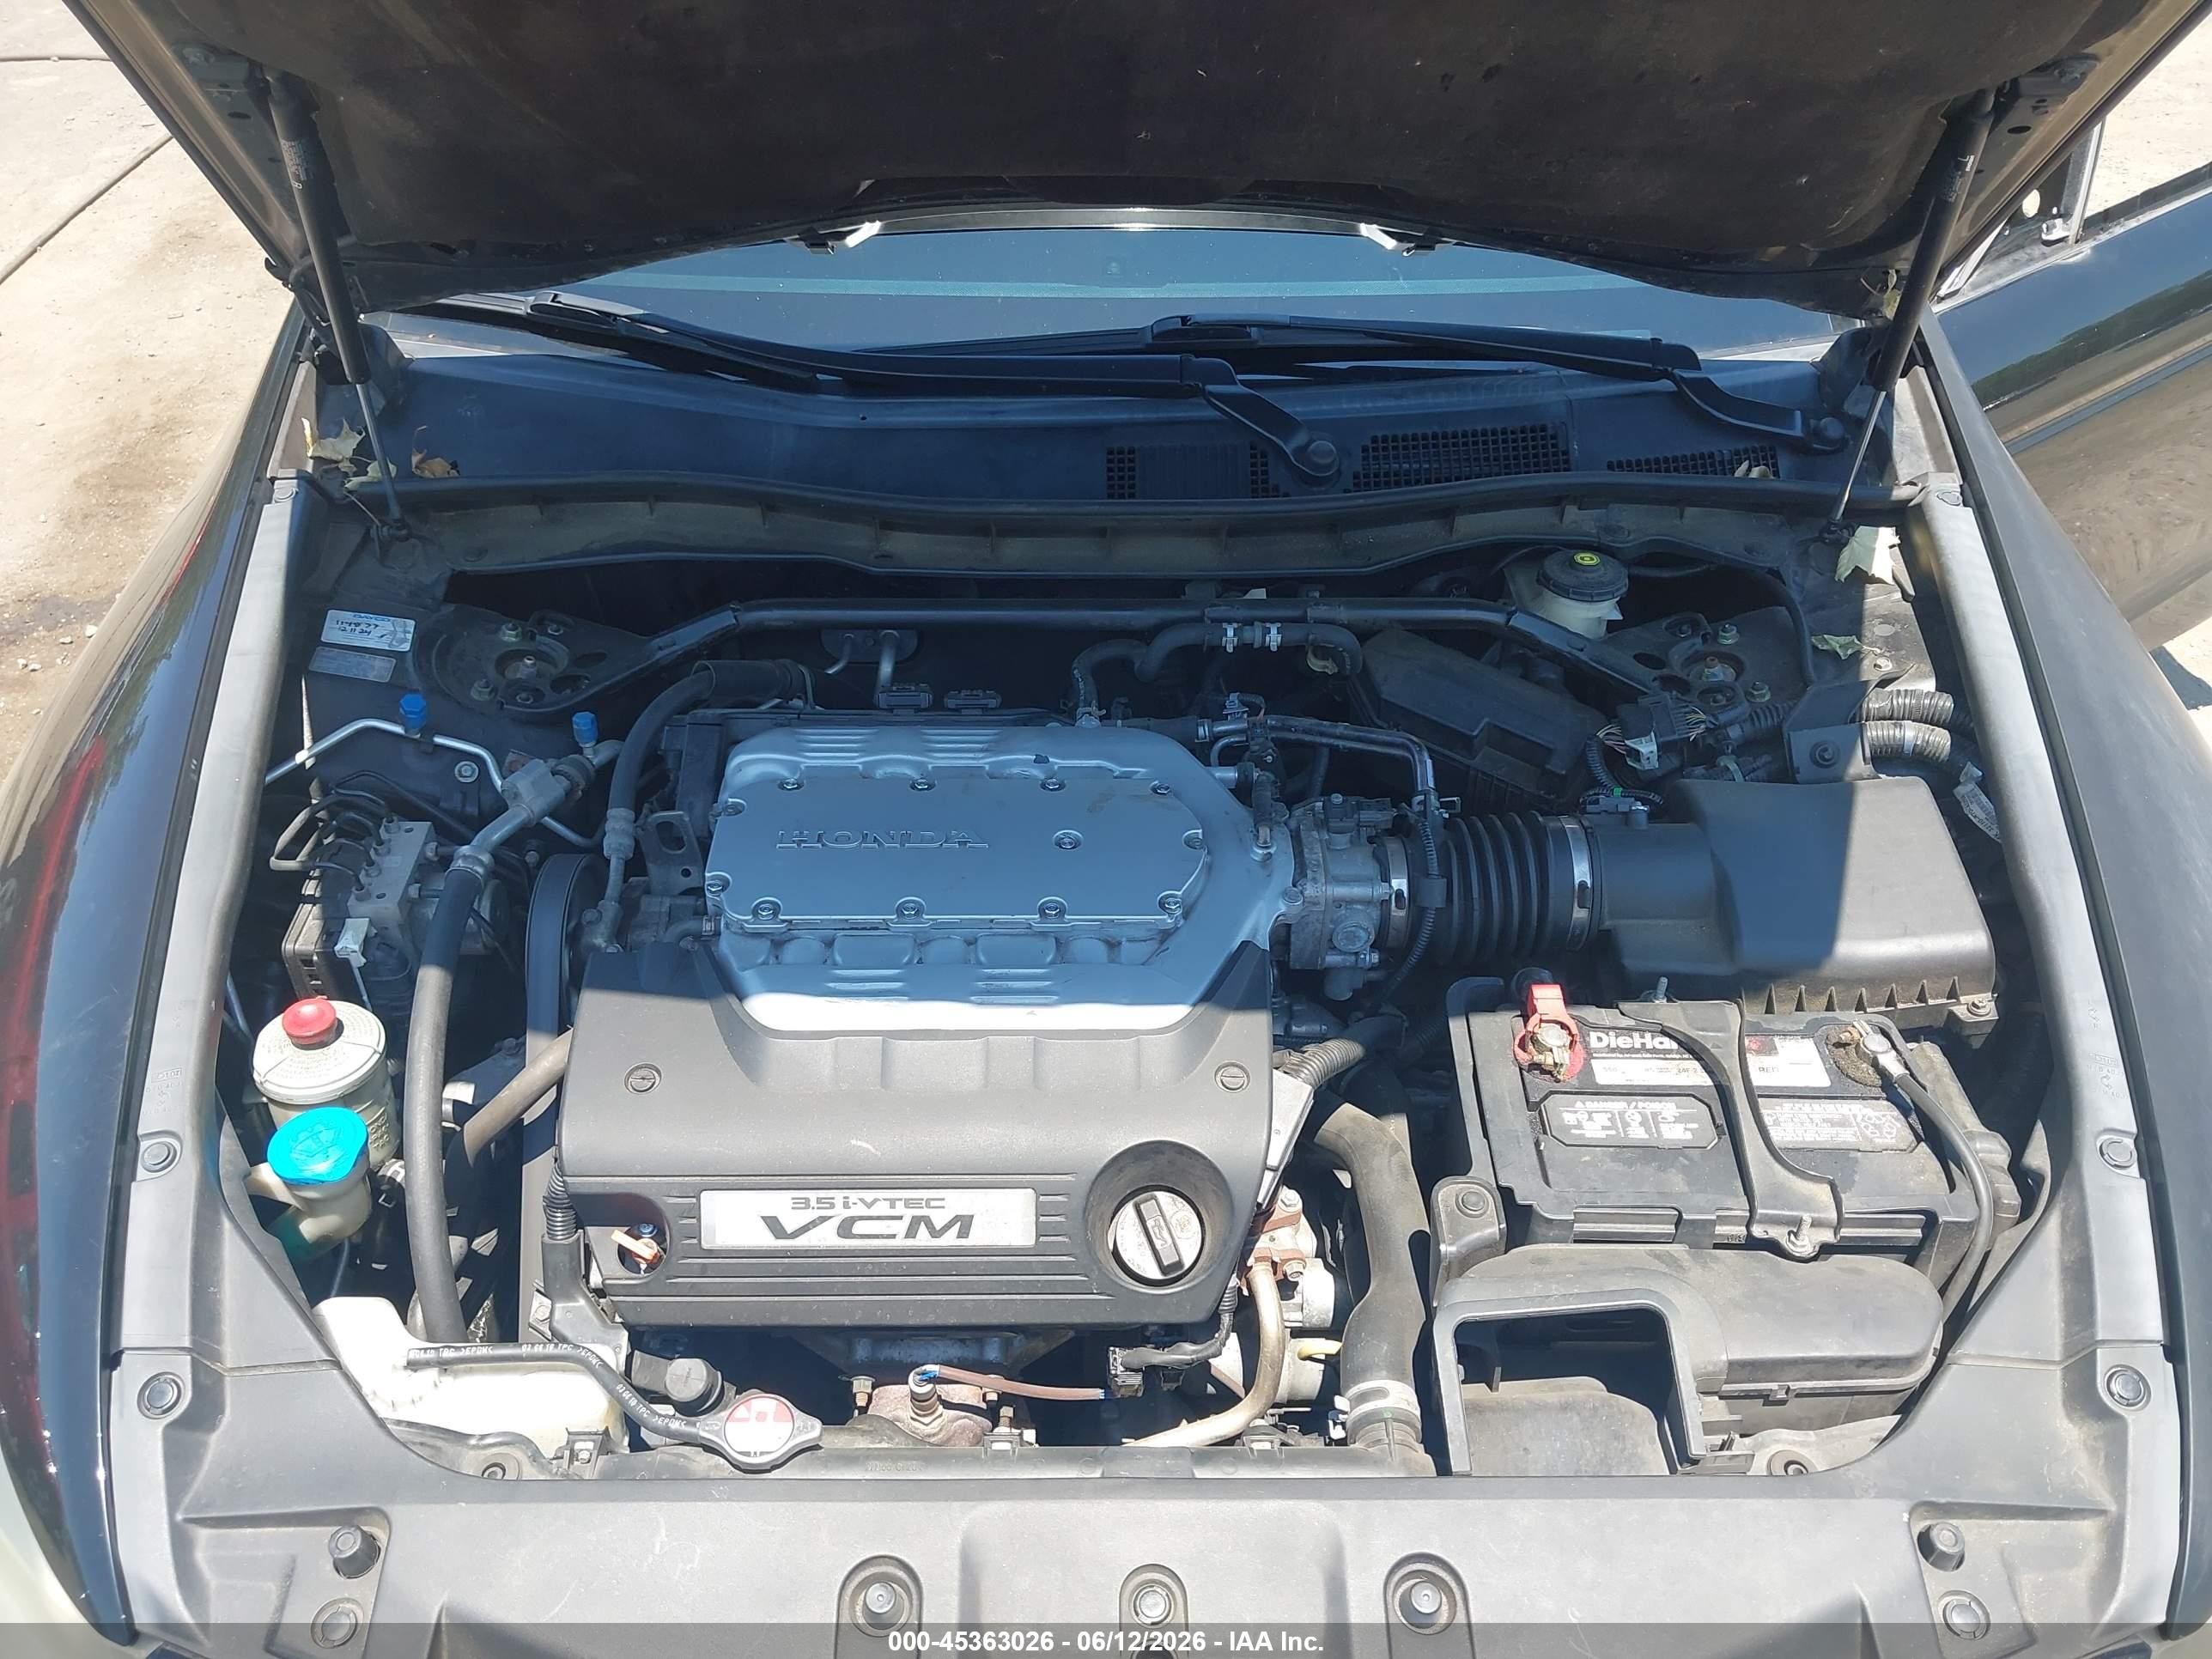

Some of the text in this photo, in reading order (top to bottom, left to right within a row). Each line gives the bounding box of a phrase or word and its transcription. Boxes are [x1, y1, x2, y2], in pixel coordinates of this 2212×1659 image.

[776, 830, 988, 849] HONDA
[1589, 1030, 1679, 1049] DieHar
[790, 1195, 946, 1211] 3.5 i-VTEC
[760, 1213, 975, 1240] VCM
